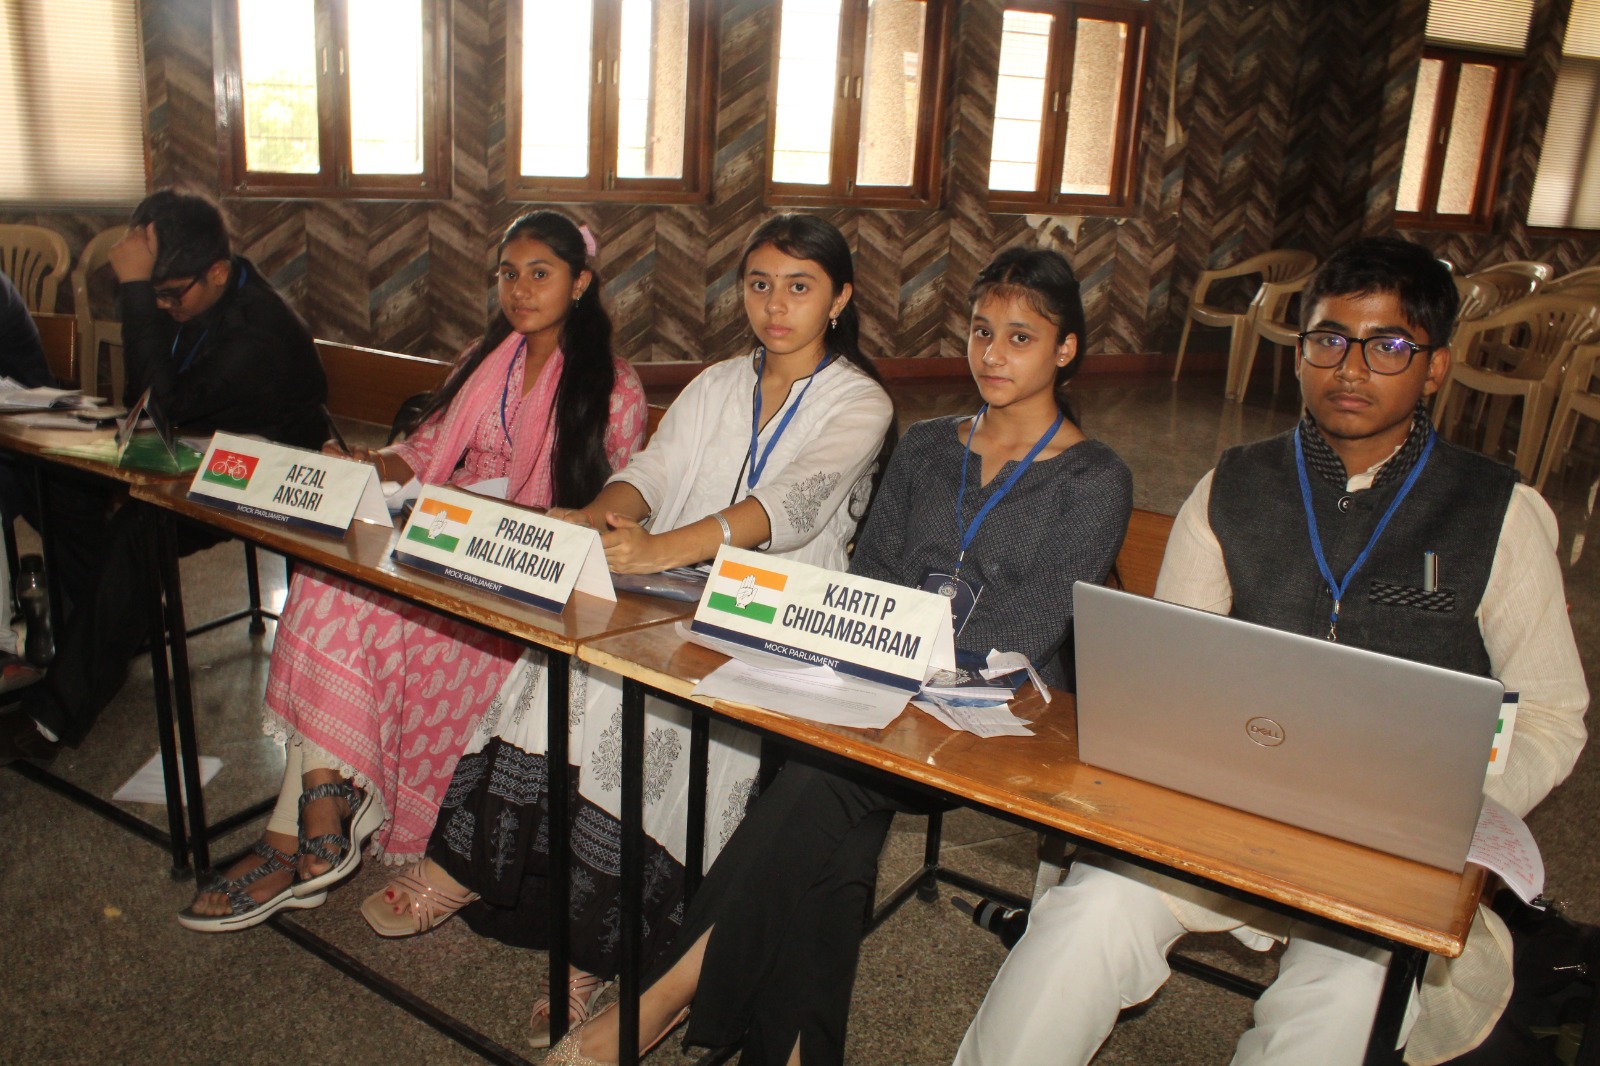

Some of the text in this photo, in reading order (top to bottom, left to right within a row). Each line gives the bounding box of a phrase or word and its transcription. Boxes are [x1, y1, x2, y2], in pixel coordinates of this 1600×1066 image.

[286, 464, 327, 489] AFZAL
[272, 484, 323, 512] ANSARI
[237, 505, 290, 522] MOCK PARLIAMENT
[495, 517, 555, 552] PRABHA
[465, 536, 565, 584] MALLIKARJUN
[444, 568, 503, 592] MOCK PARLIAMENT
[822, 583, 896, 621] KARTI P
[782, 603, 922, 660] CHIDAMBARAM
[764, 642, 840, 669] MOCK PARLIAMENT
[1250, 725, 1281, 740] DELL
